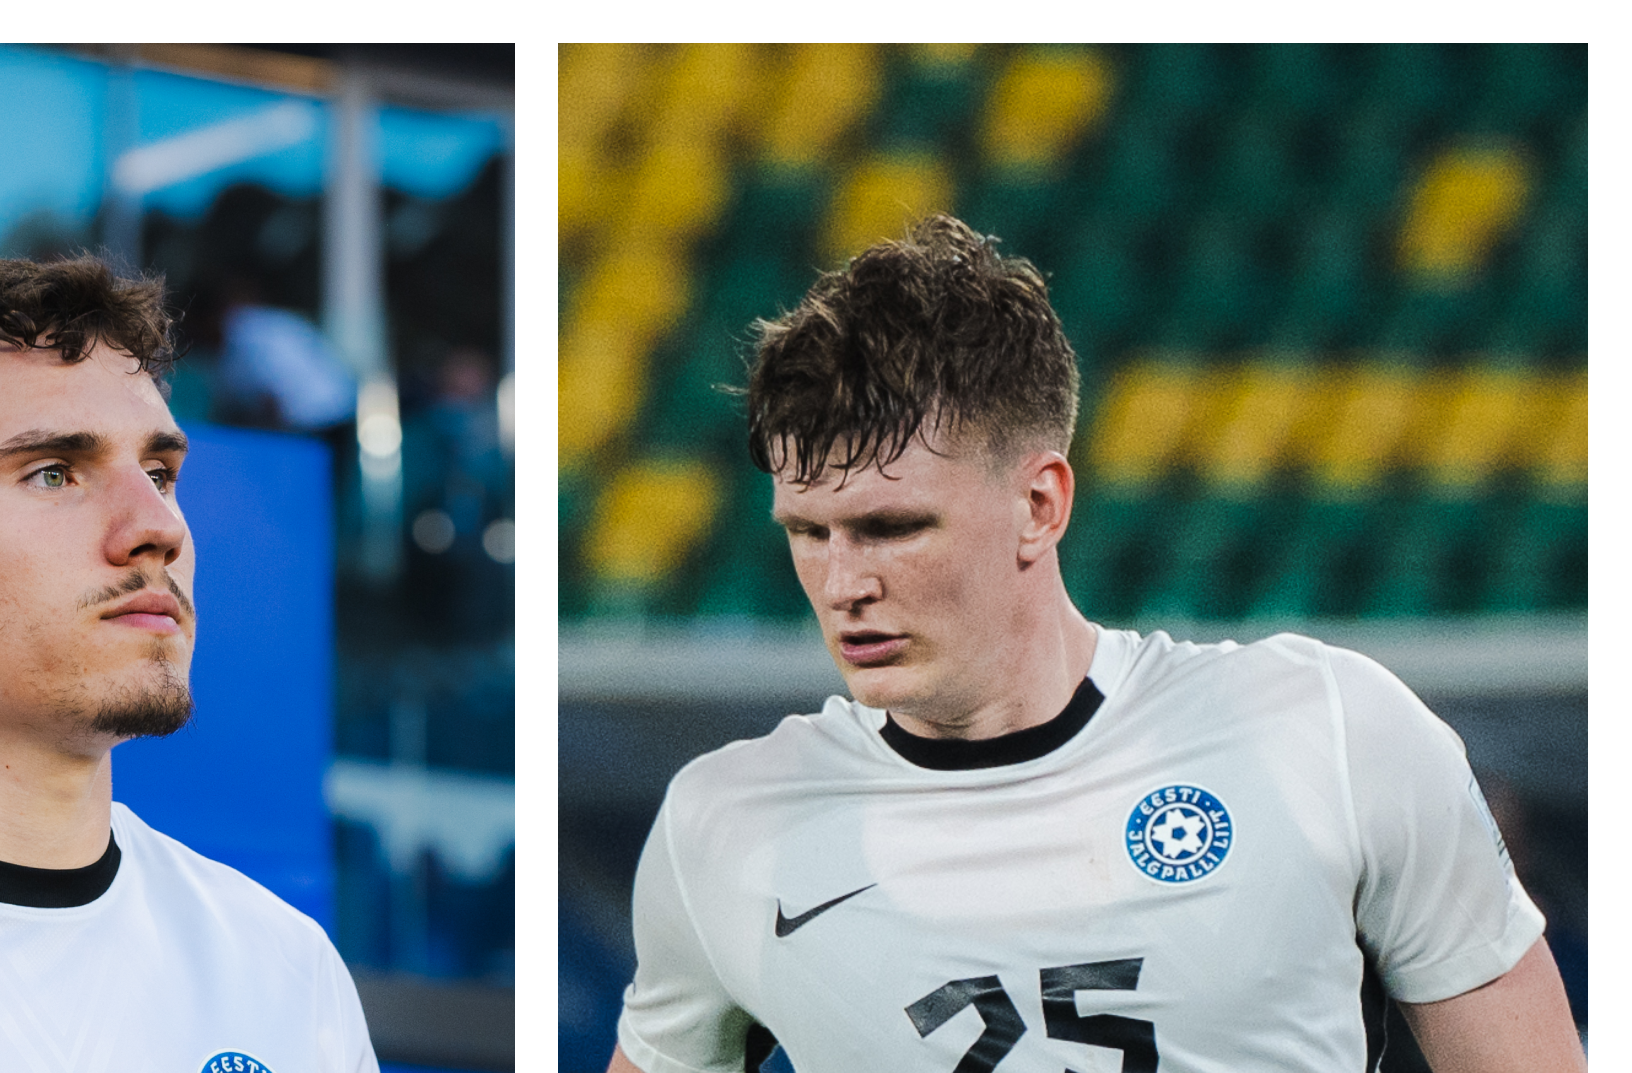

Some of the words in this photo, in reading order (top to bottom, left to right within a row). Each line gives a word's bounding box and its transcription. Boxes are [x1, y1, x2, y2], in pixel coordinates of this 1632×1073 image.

[1139, 787, 1202, 816] EESTI
[1128, 830, 1220, 881] JALGPALLI
[1208, 809, 1230, 849] LIIT
